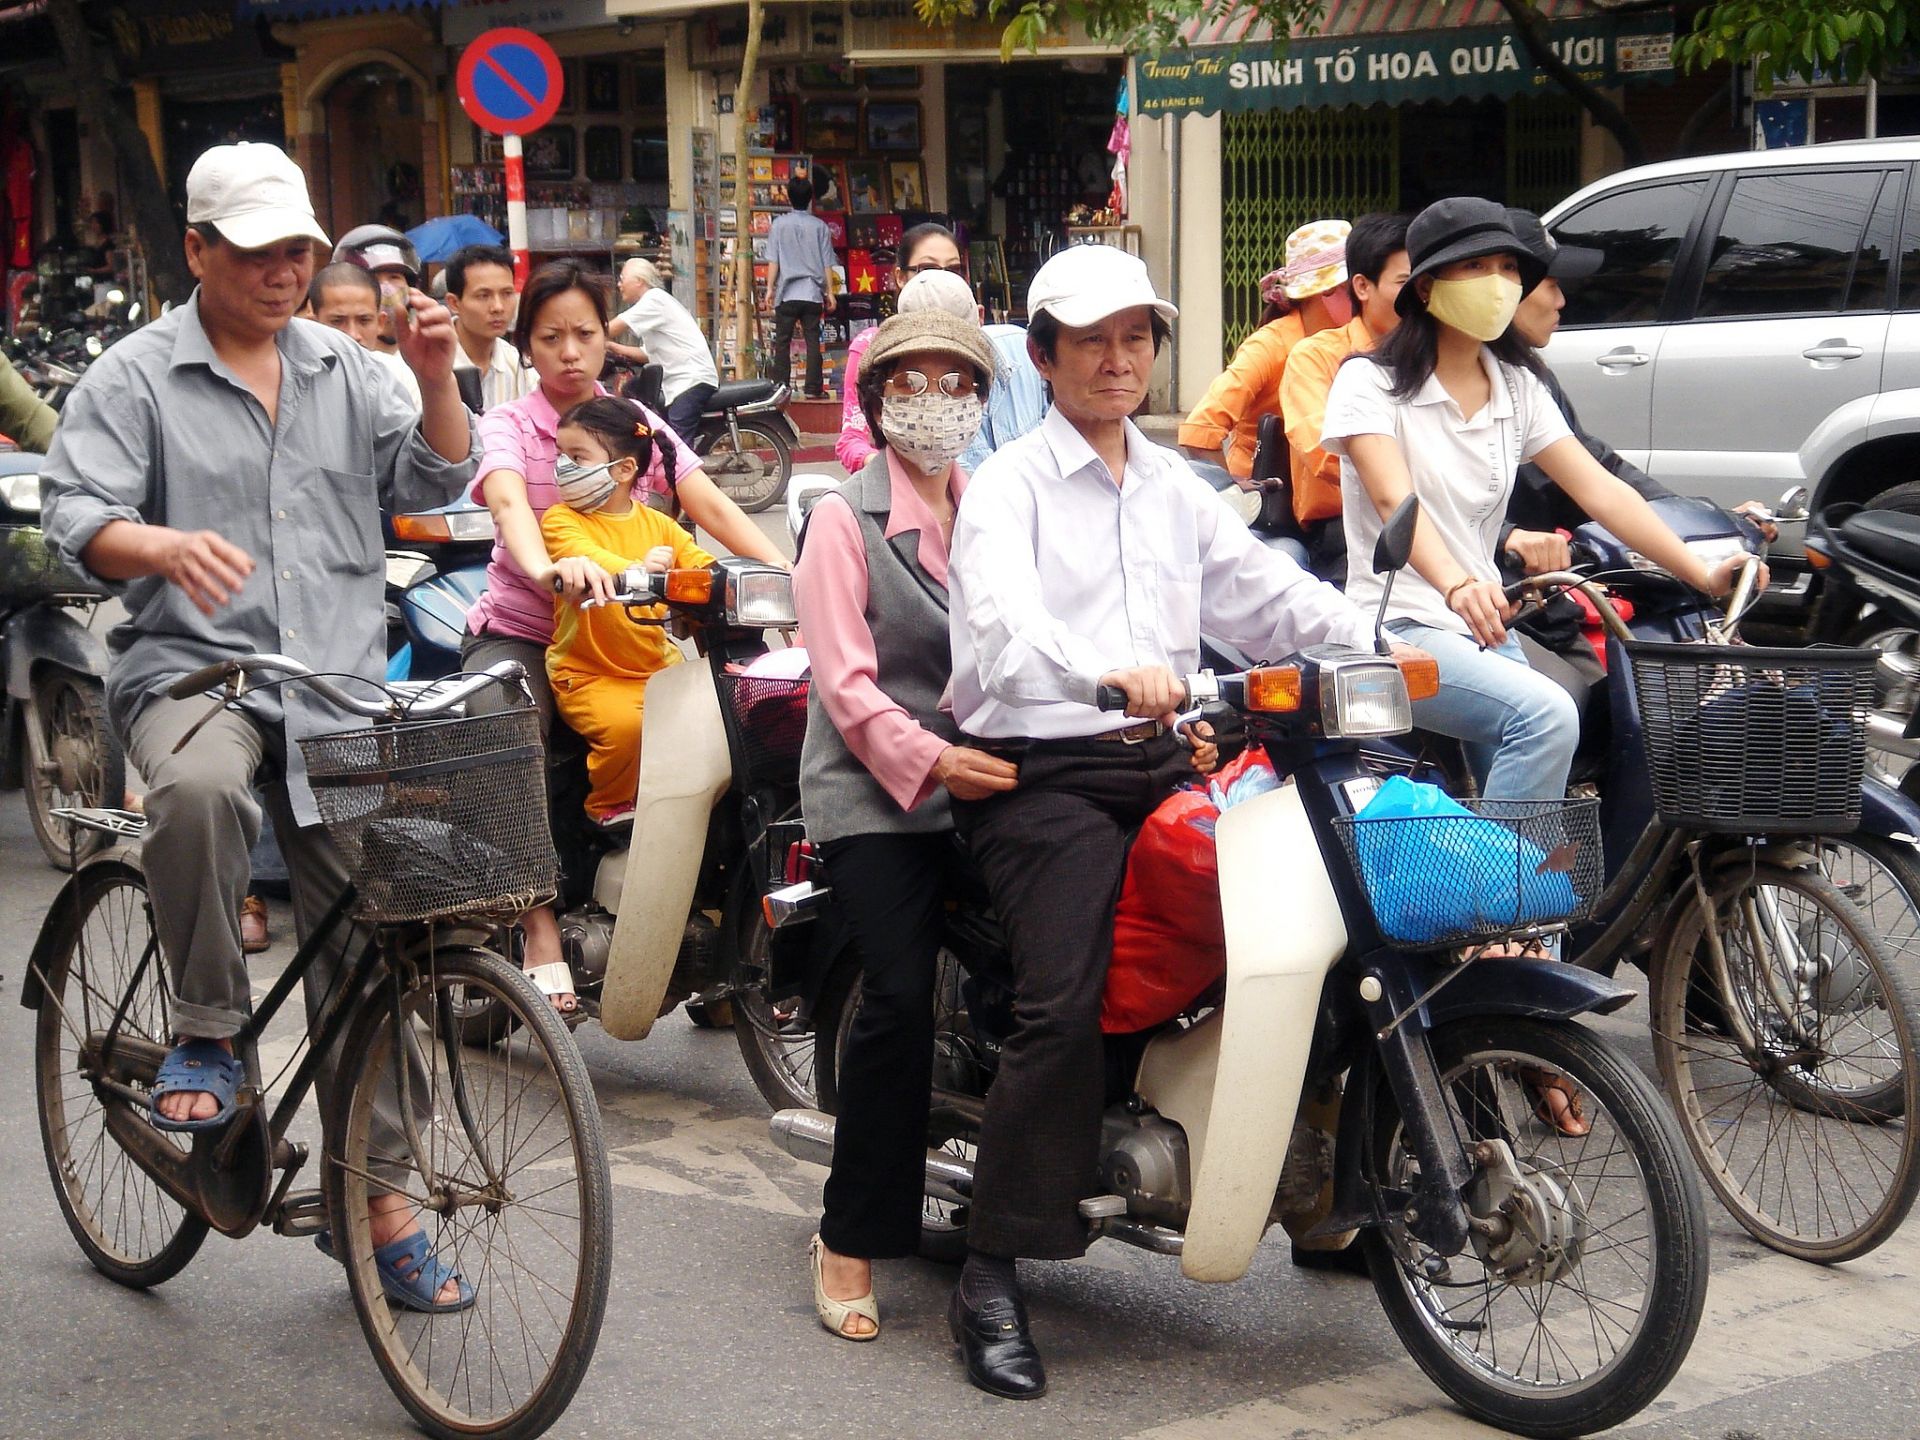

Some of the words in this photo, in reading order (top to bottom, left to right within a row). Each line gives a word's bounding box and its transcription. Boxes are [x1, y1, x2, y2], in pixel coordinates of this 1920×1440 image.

[1142, 60, 1192, 80] Trang
[1229, 58, 1303, 89] SINH
[1313, 46, 1361, 84] TỐ
[1367, 50, 1439, 82] HOA
[1450, 35, 1520, 75] QUẢ
[1536, 36, 1604, 69] ƯƠI
[1144, 99, 1159, 109] 46
